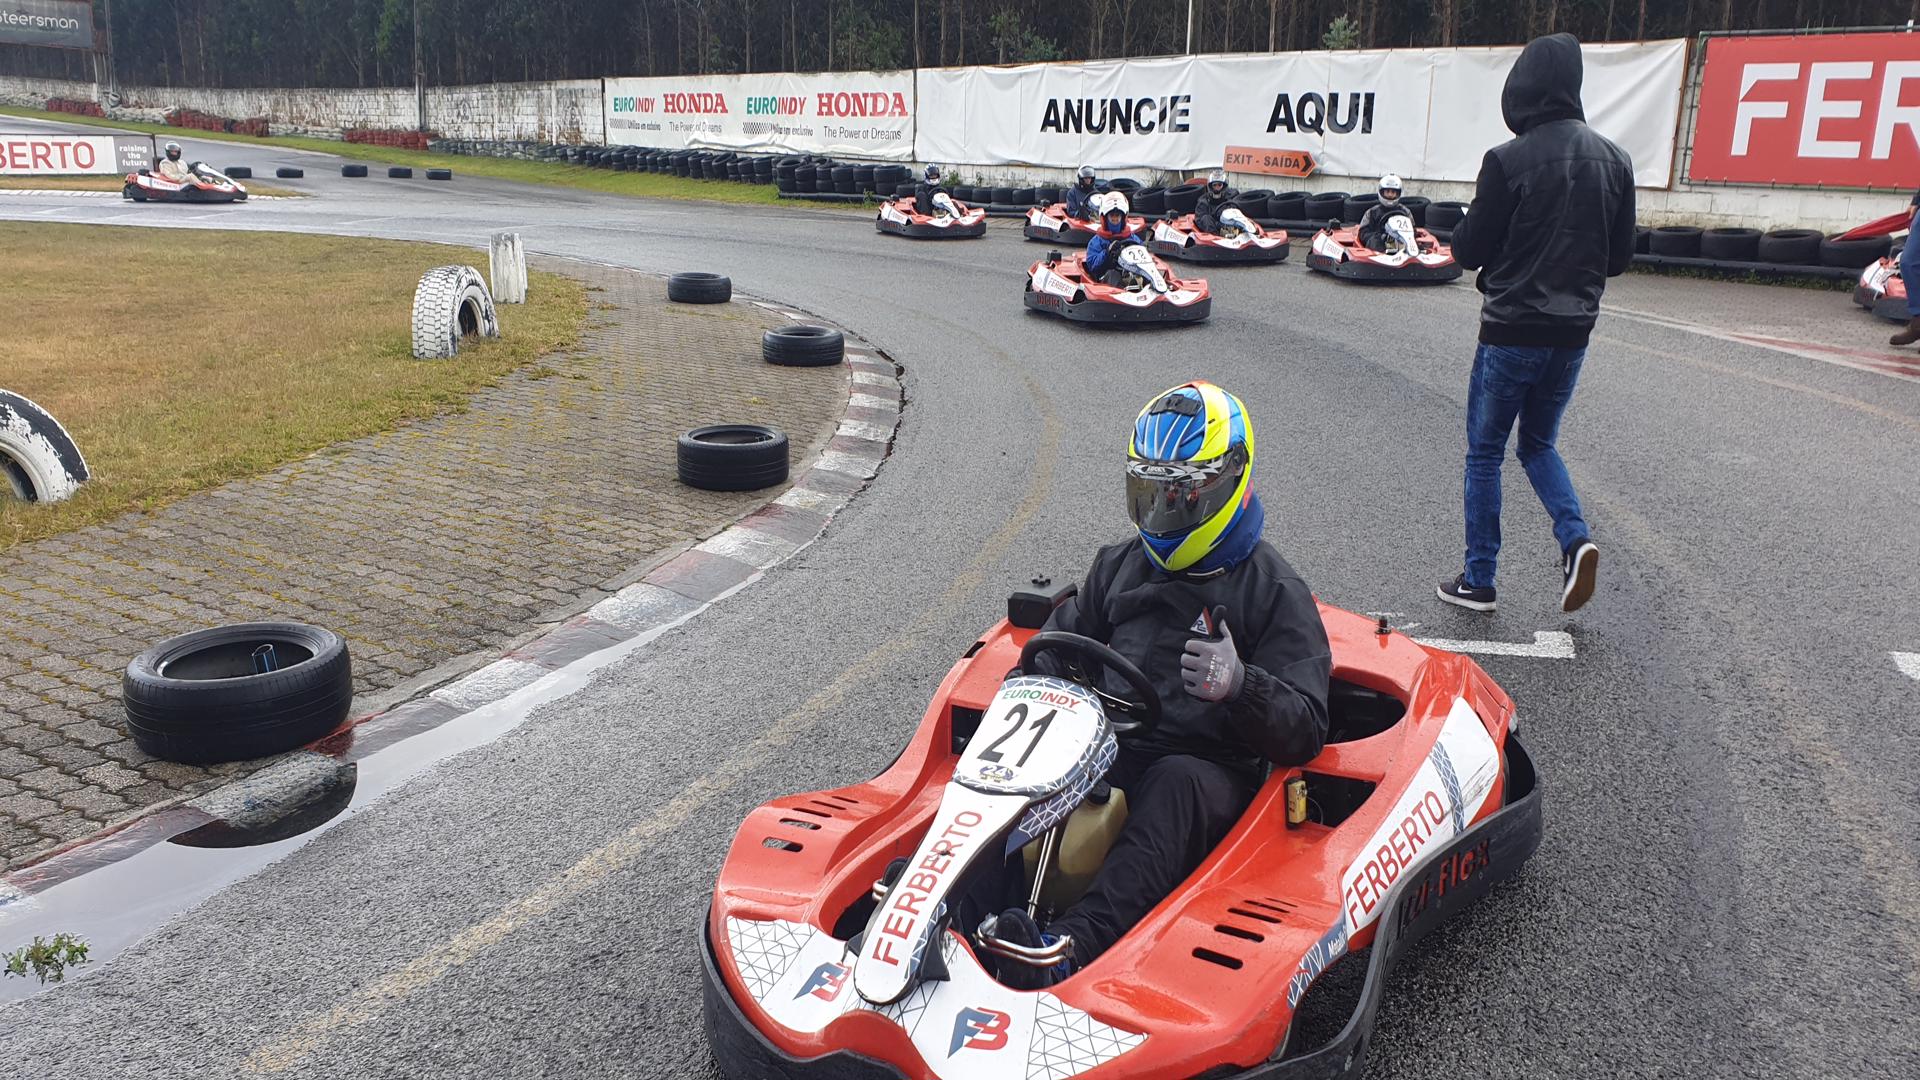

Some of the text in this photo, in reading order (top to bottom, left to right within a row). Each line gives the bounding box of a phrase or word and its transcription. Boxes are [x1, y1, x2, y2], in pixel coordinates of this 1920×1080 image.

[0, 10, 79, 29] teersman
[613, 93, 729, 114] EUROINDY HONDA
[746, 92, 909, 117] EUROINDY HONDA
[1040, 95, 1191, 135] ANUNCIE
[1266, 92, 1375, 136] AQUI
[1731, 61, 1920, 160] FER
[824, 126, 902, 140] The Power of Dreams
[1226, 153, 1253, 165] EXIT
[1263, 155, 1300, 169] SAÍDA
[1002, 689, 1081, 709] EUROINDY
[977, 703, 1058, 768] 21
[1344, 791, 1445, 930] FERBERTO
[872, 810, 983, 966] FERBERTO
